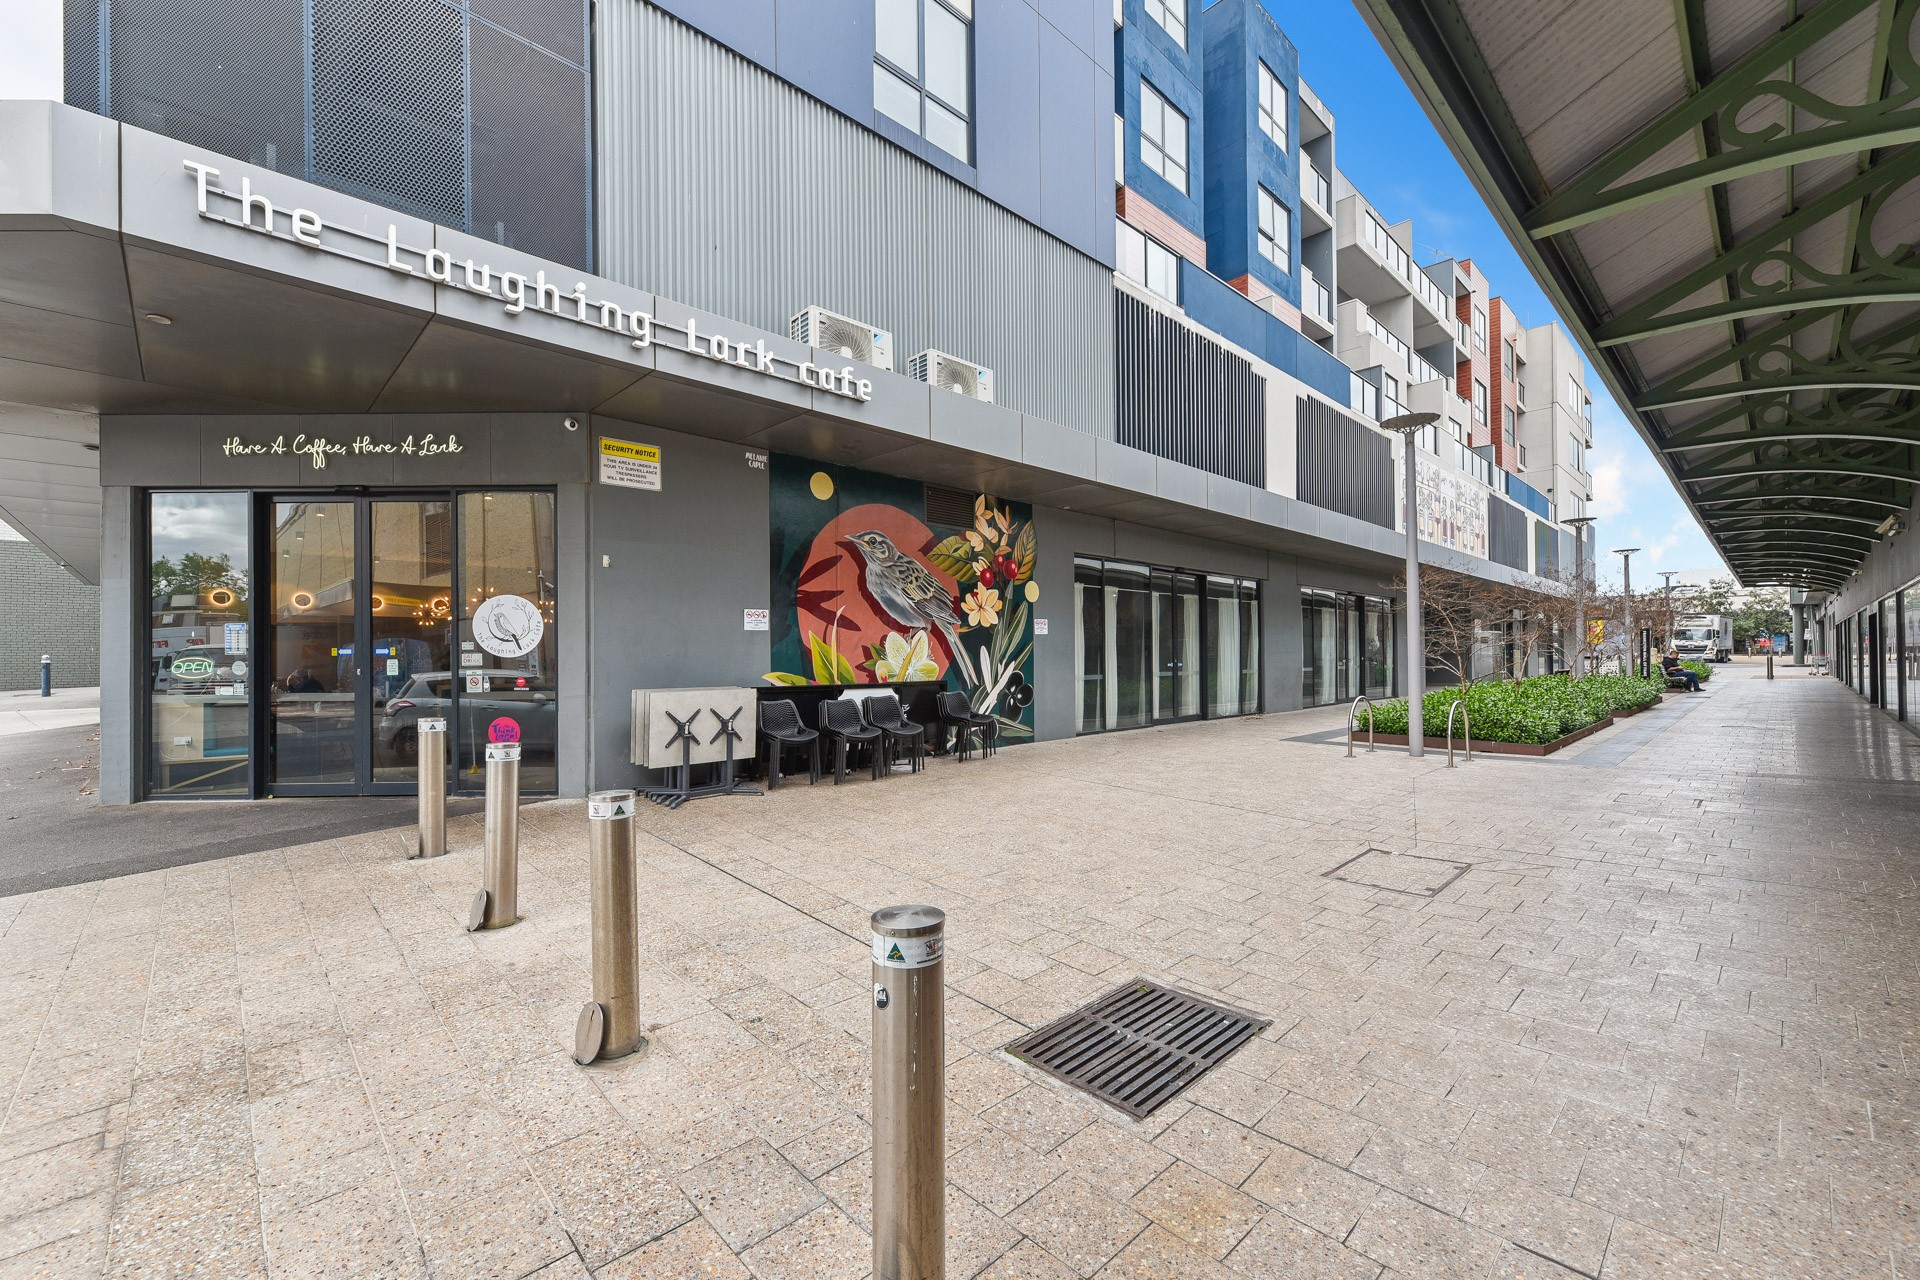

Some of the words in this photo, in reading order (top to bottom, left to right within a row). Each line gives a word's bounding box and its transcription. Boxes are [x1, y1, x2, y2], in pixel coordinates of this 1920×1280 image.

[183, 159, 321, 248] The
[387, 223, 654, 348] Laughing
[687, 317, 775, 374] Lark
[223, 436, 267, 457] Have
[271, 435, 287, 455] A
[293, 434, 347, 469] Coffee,
[353, 435, 398, 455] Have
[401, 435, 417, 455] A
[418, 433, 463, 456] Lark
[604, 444, 633, 454] SECURITY
[635, 449, 657, 458] NOTICE
[616, 471, 647, 480] TRESPASSERS
[625, 467, 658, 476] SURVEILLANCE
[626, 478, 656, 486] PROSECUTED
[171, 661, 214, 674] OPEN
